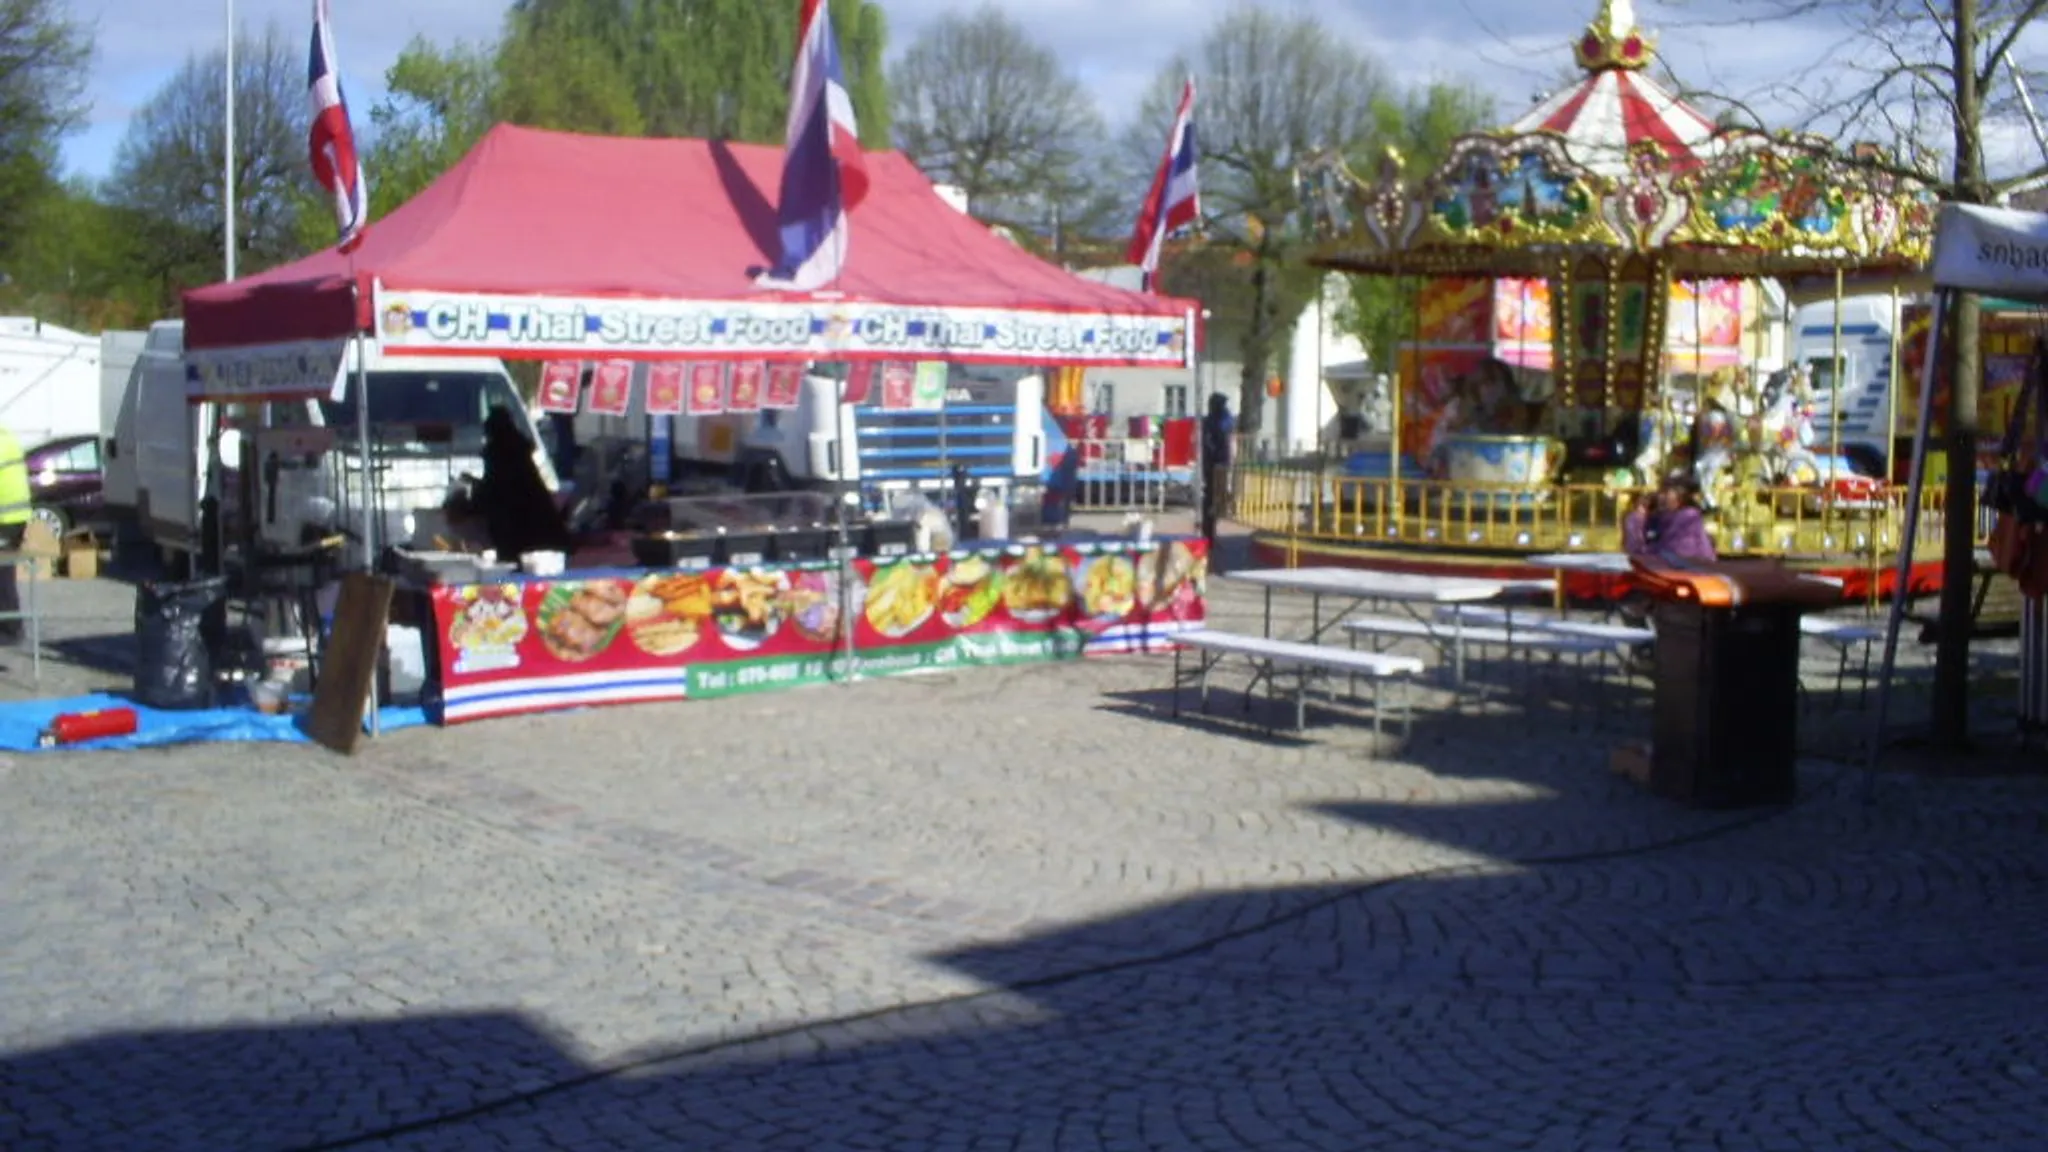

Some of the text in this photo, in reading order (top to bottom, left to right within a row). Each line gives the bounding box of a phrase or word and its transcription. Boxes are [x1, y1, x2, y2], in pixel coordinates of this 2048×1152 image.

[426, 302, 812, 345] CH Thai Street Food
[861, 313, 1160, 353] CH Thai Street Food
